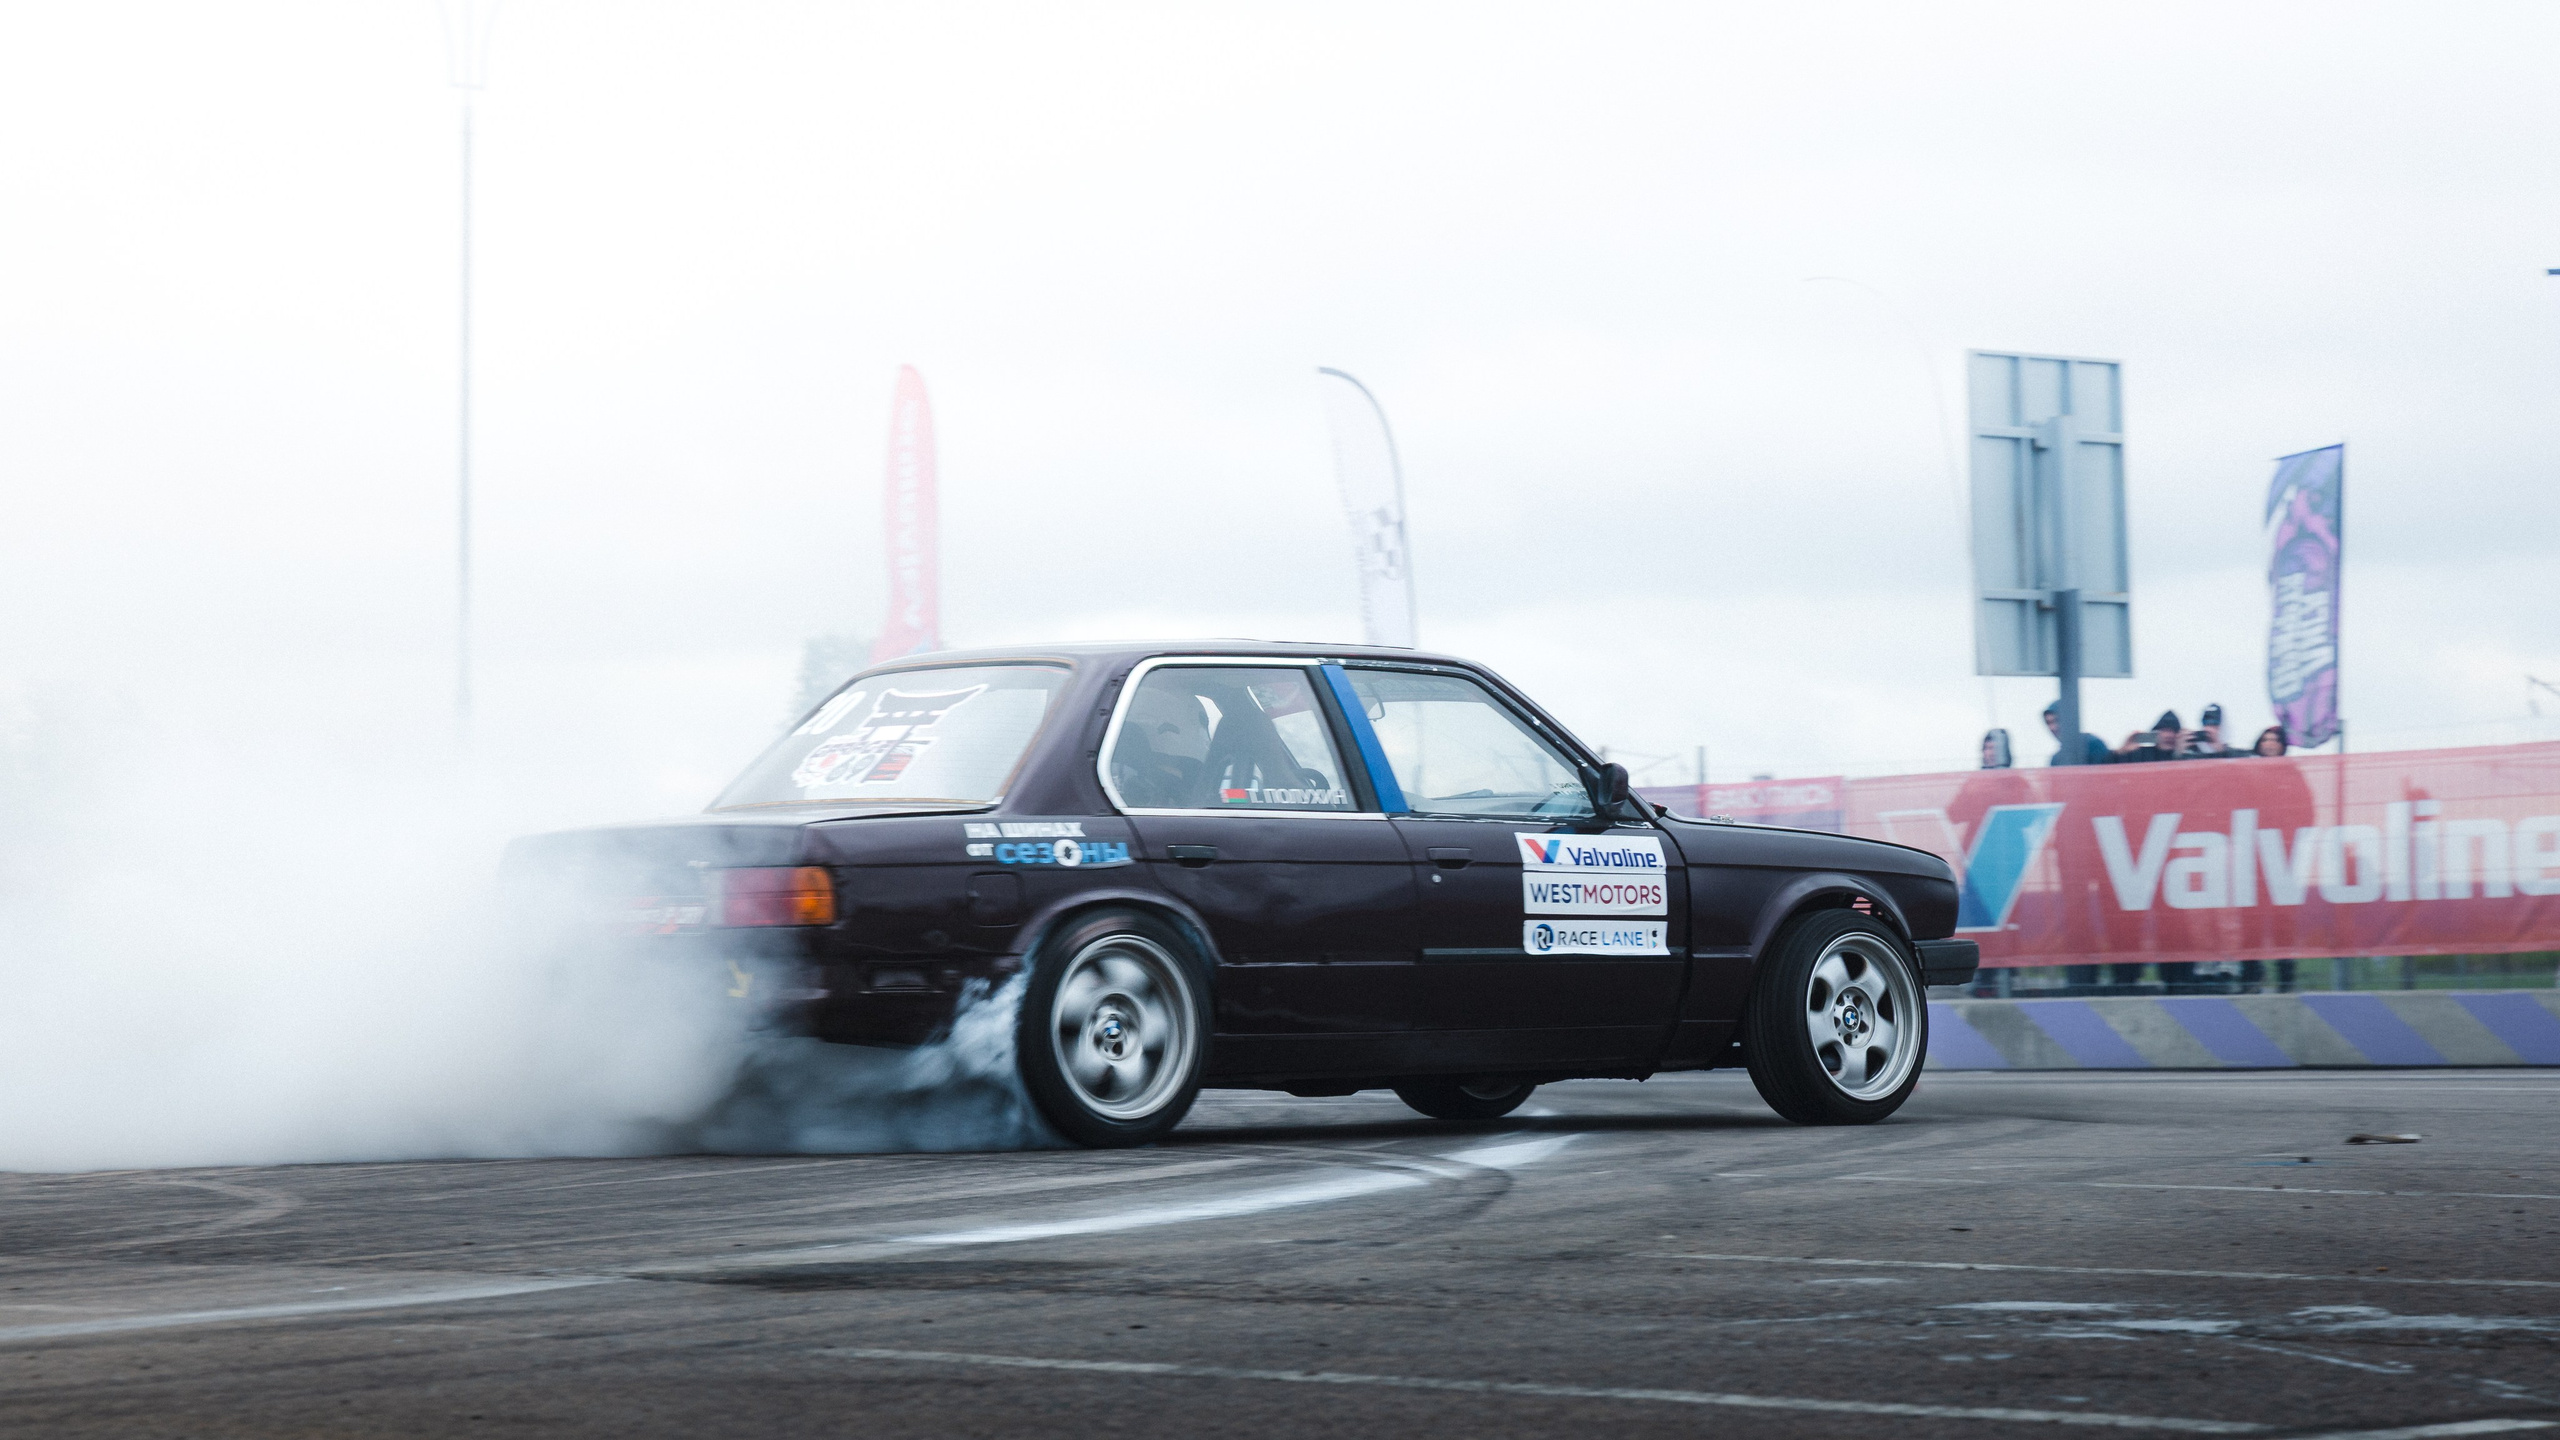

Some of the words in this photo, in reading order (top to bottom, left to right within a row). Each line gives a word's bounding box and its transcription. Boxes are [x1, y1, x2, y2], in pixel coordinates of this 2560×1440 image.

[1263, 788, 1349, 805] ПОЛУХИН
[1566, 847, 1657, 868] Valvoline
[2092, 800, 2560, 912] Valvoline
[1530, 883, 1662, 905] WESTMOTORS
[1557, 931, 1598, 946] RACE
[1602, 931, 1643, 947] LANE
